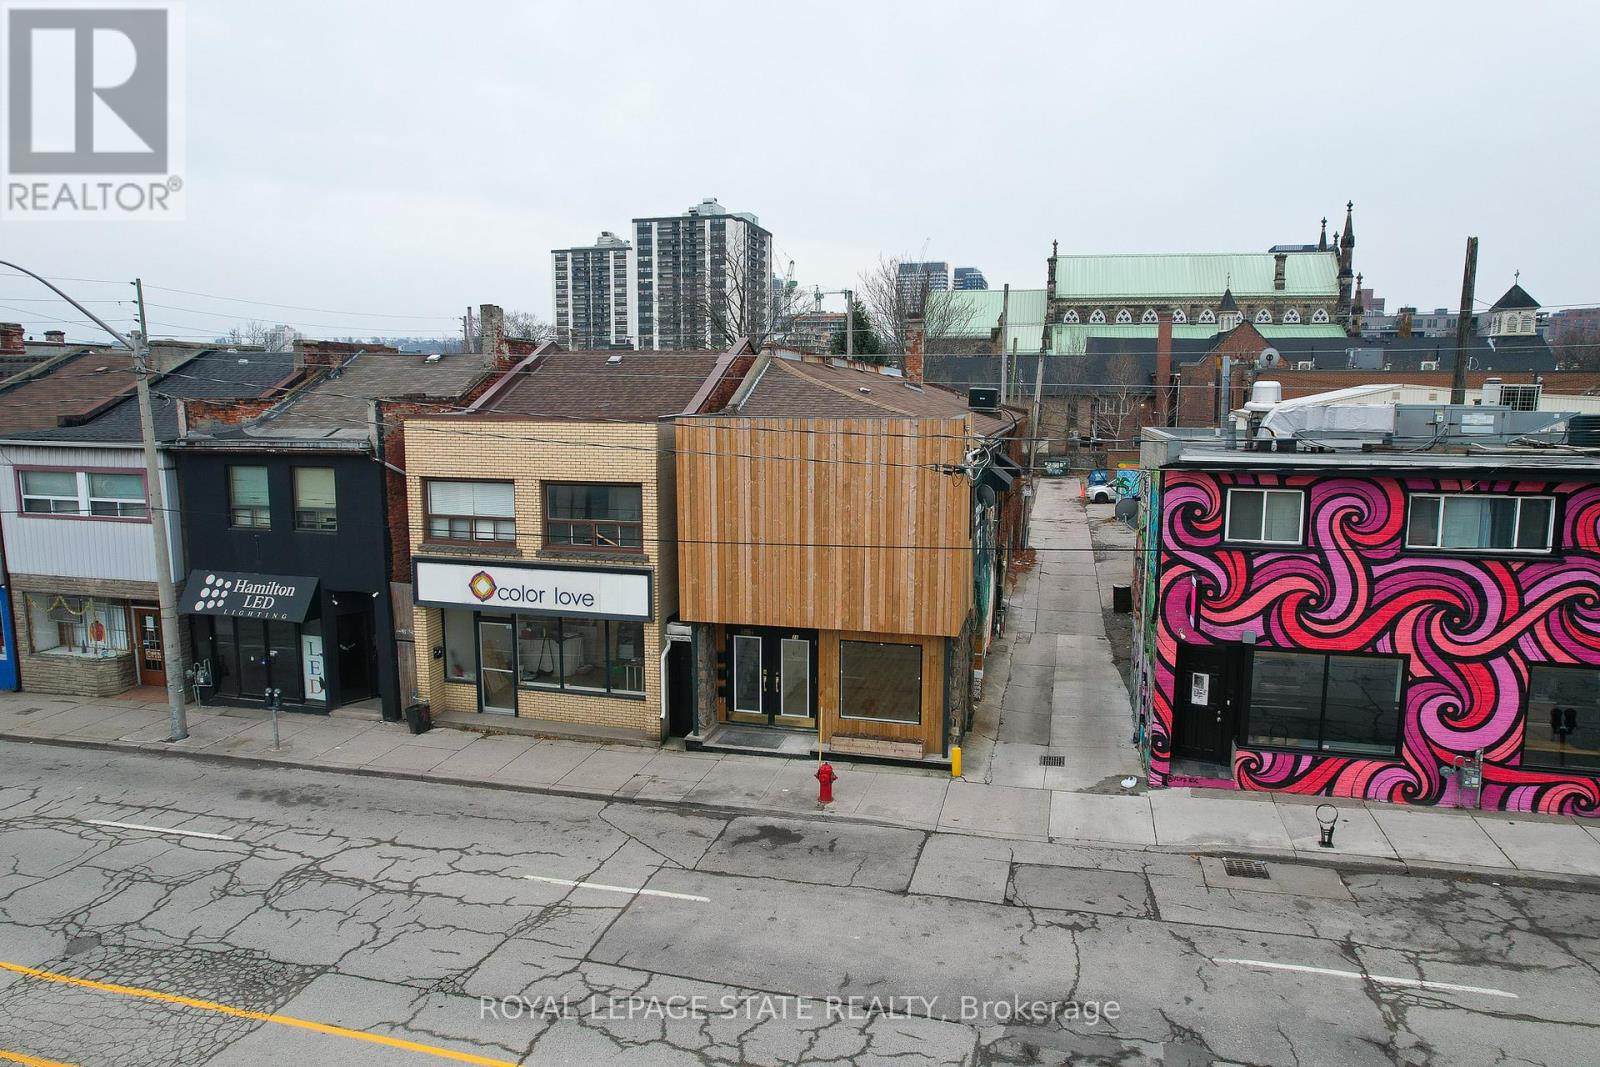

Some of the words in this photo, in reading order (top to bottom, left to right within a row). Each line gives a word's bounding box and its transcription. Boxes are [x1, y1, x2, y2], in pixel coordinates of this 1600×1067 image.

[233, 579, 296, 596] Hamilton
[243, 595, 275, 609] LED
[497, 585, 546, 603] color
[555, 586, 594, 607] love
[223, 609, 288, 620] LIGHTING
